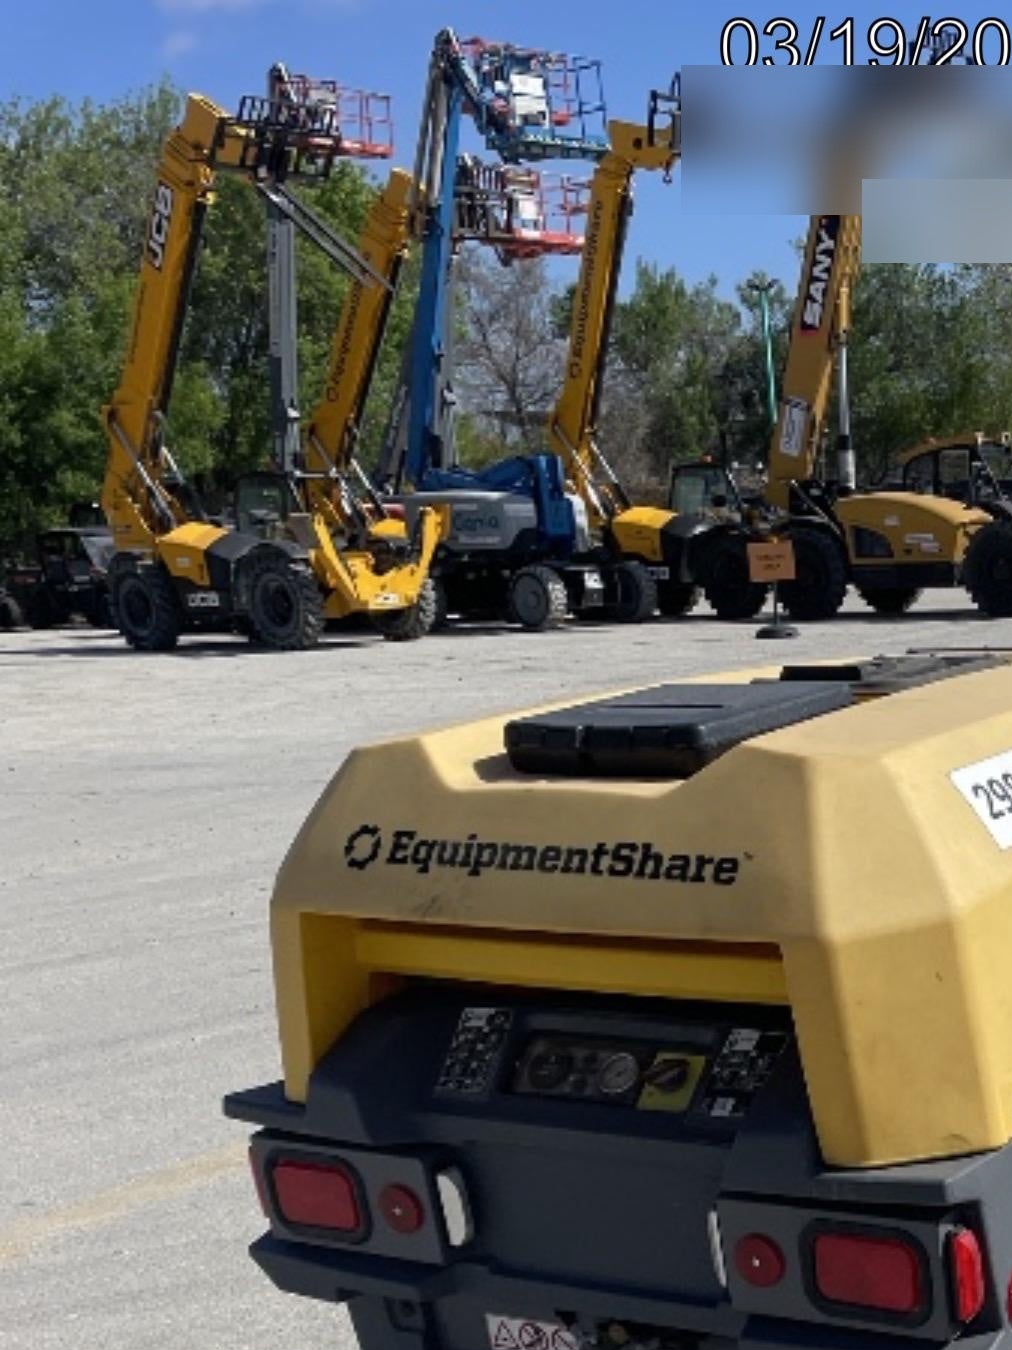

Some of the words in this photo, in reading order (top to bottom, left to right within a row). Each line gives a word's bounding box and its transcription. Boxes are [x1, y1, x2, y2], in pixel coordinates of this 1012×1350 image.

[149, 182, 173, 271] JCB
[803, 228, 836, 328] SANY
[386, 830, 739, 885] EquipmentShare
